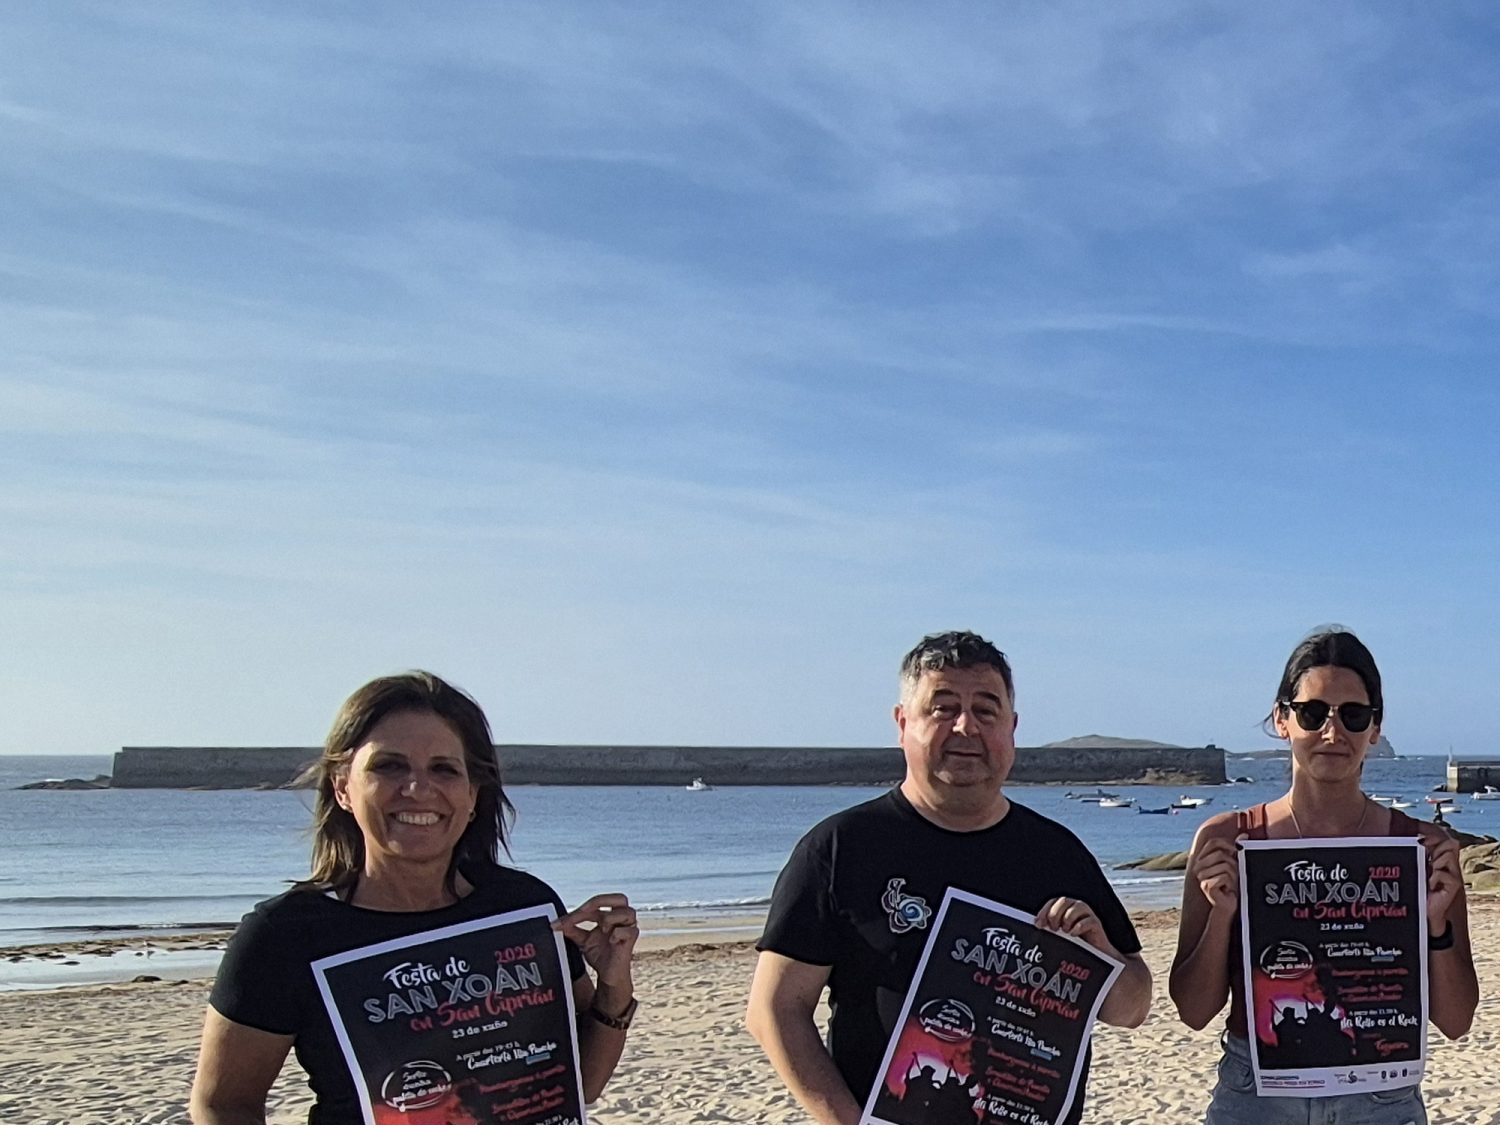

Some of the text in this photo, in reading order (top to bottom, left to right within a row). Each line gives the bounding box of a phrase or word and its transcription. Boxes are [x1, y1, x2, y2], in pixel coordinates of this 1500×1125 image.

[1284, 860, 1349, 881] Festa de
[1265, 882, 1317, 904] SAN
[1293, 908, 1309, 918] en
[1314, 900, 1346, 919] San
[951, 938, 1008, 974] SAN
[982, 928, 1042, 962] Festa de
[383, 957, 470, 988] Festa de
[974, 972, 992, 986] en
[994, 974, 1027, 998] San
[364, 985, 438, 1023] SAN
[410, 1016, 432, 1031] en
[437, 1002, 480, 1027] San
